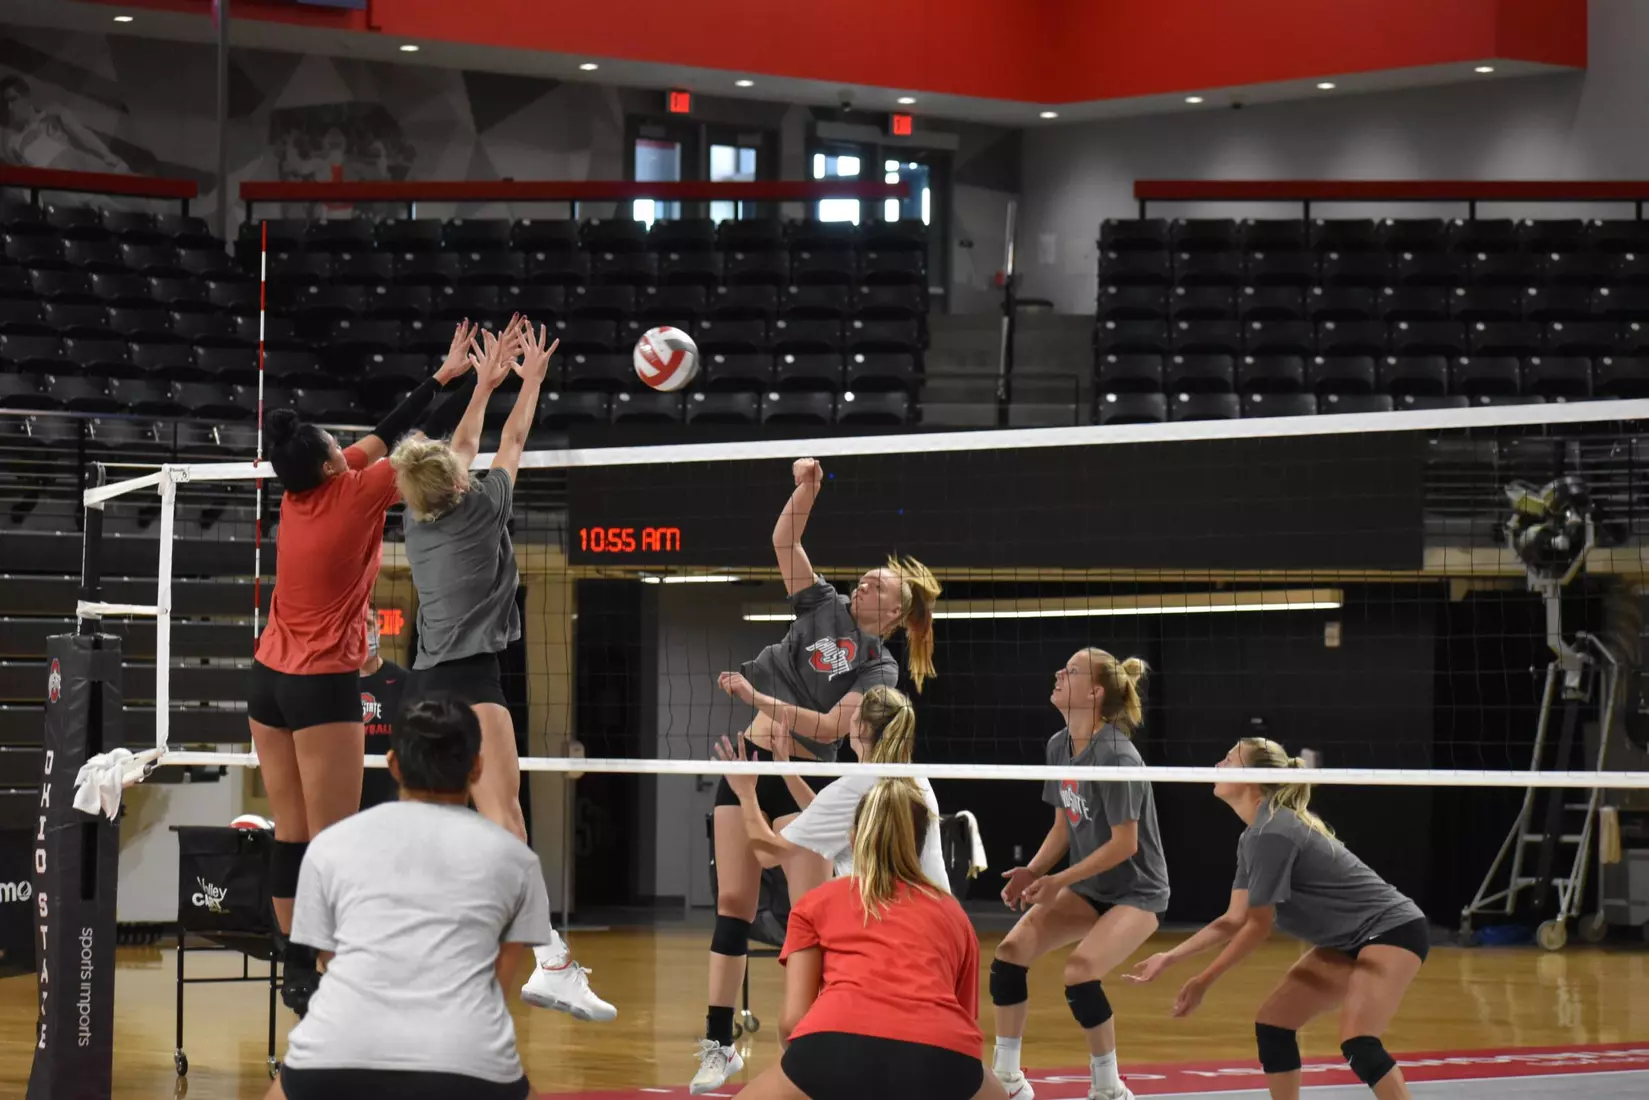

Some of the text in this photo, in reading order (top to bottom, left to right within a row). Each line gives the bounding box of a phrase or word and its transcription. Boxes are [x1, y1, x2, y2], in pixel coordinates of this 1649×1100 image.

[642, 527, 680, 552] AM
[35, 750, 54, 874] OHIO
[38, 892, 48, 1049] STATE
[77, 927, 93, 1047] sports imports
